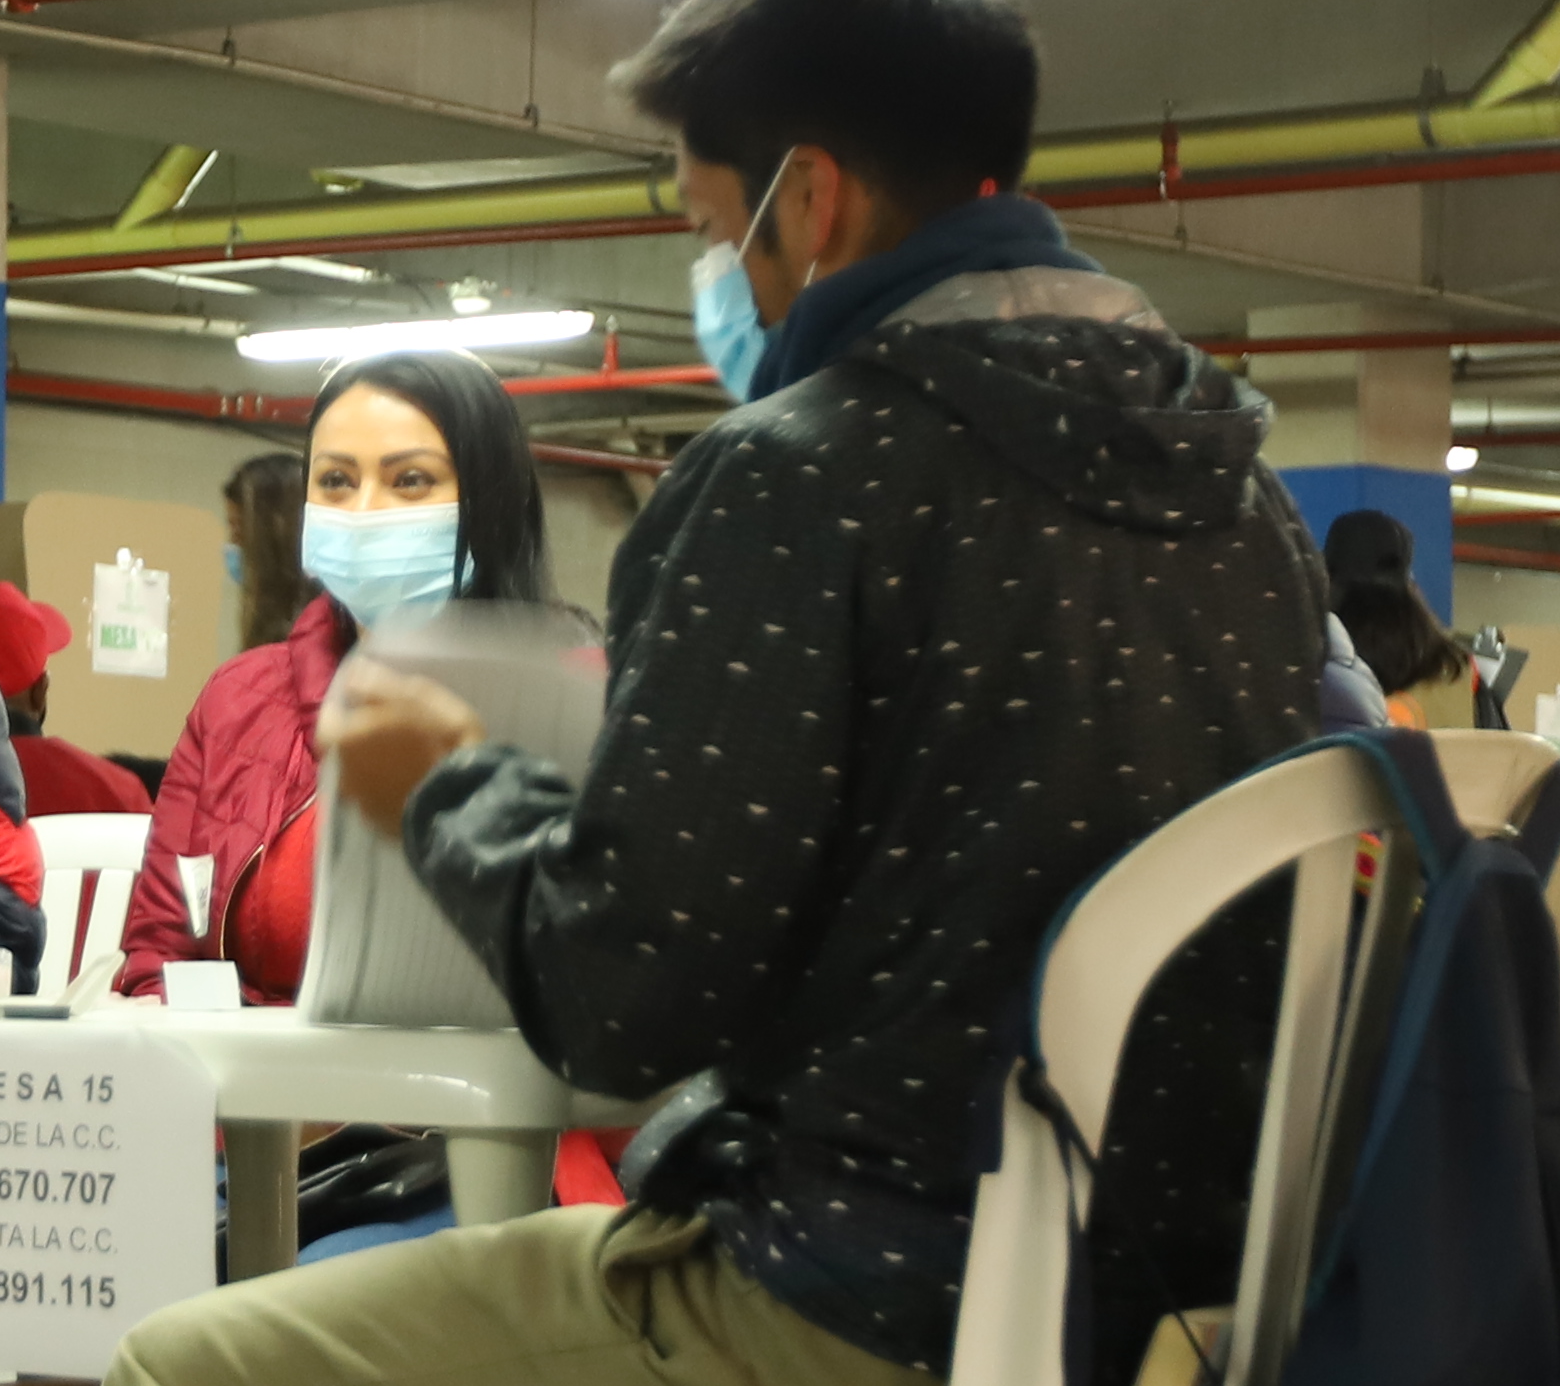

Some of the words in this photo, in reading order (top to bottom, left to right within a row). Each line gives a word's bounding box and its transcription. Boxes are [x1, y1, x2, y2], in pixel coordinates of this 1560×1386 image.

[83, 1074, 114, 1104] 15
[36, 1122, 65, 1148] LA
[72, 1123, 121, 1151] C.C.
[32, 1225, 61, 1250] LA
[69, 1226, 119, 1254] C.C.
